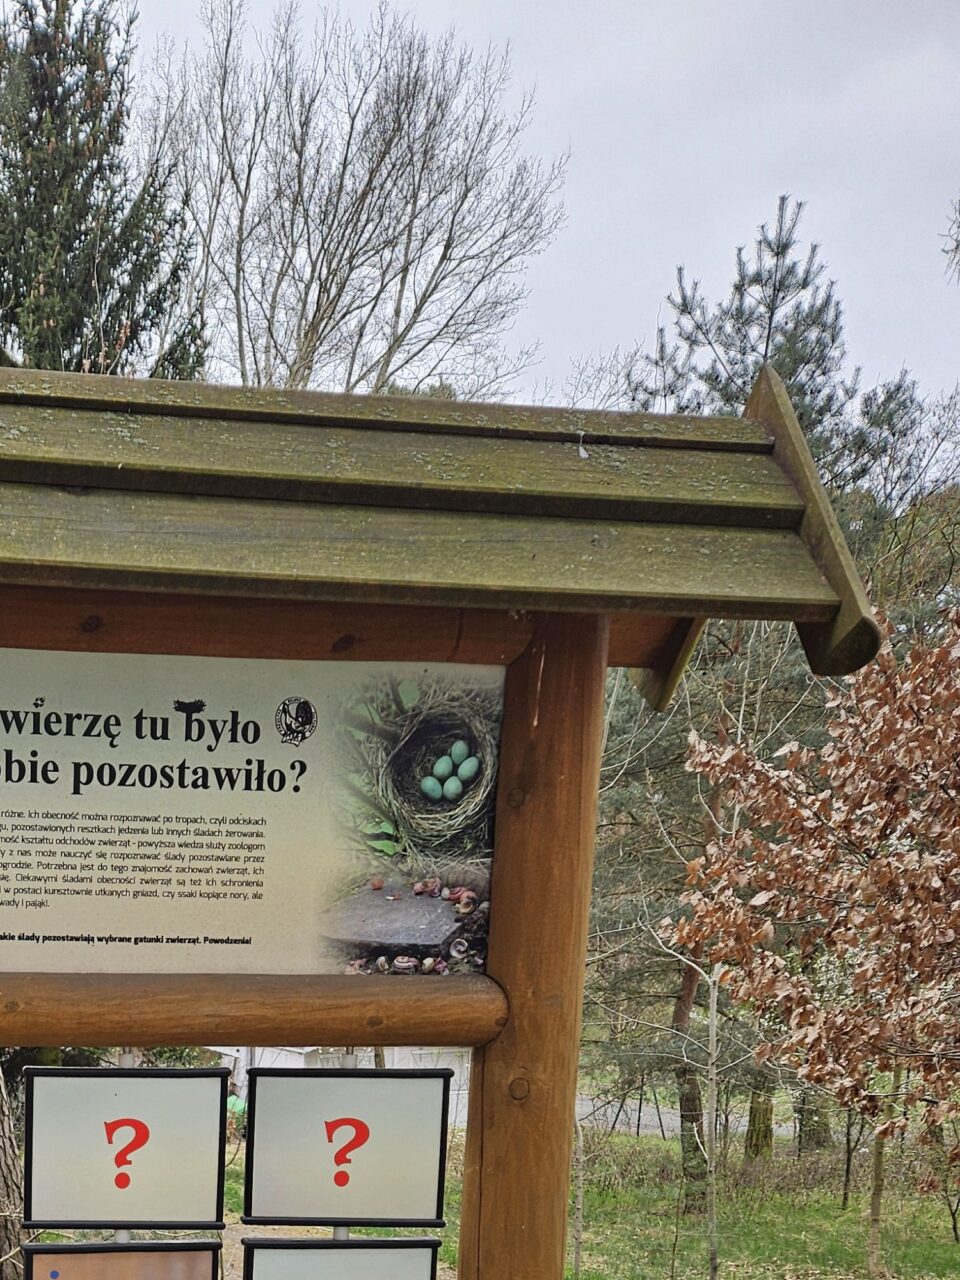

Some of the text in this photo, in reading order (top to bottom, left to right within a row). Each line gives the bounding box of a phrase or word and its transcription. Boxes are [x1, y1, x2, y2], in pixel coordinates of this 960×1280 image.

[133, 708, 170, 741] tu
[180, 703, 261, 752] było
[71, 757, 308, 796] pozostawiło?
[0, 809, 26, 818] różne.
[27, 809, 40, 819] Ich
[41, 810, 80, 820] obecność
[81, 813, 108, 821] można
[162, 816, 174, 825] po
[174, 815, 208, 825] tropach,
[208, 816, 228, 827] czyli
[228, 816, 267, 826] odciskach
[10, 823, 76, 834] pozostawionych
[77, 825, 116, 834] resztkach
[117, 825, 150, 836] jedzenia
[151, 826, 164, 836] lub
[165, 827, 191, 838] innych
[193, 827, 223, 837] śladach
[21, 835, 54, 845] kształtu
[55, 836, 96, 846] odchodów
[97, 838, 131, 848] zwierząt
[137, 840, 176, 850] powyższa
[176, 840, 204, 849] wiedza
[227, 841, 266, 853] zoologom
[16, 849, 32, 857] nas
[34, 849, 57, 858] może
[60, 850, 92, 860] nauczyć
[95, 850, 108, 860] się
[164, 851, 186, 863] ślady
[188, 854, 241, 863] pozostawiane
[243, 855, 265, 865] przez
[36, 860, 78, 871] Potrzebna
[79, 862, 95, 873] jest
[97, 862, 108, 872] do
[110, 864, 129, 874] tego
[131, 864, 173, 874] znajomość
[174, 865, 214, 874] zachowań
[215, 866, 250, 876] zwierząt,
[252, 866, 265, 875] ich
[15, 873, 58, 884] Ciekawymi
[61, 874, 93, 883] śladami
[96, 873, 136, 885] obecności
[139, 876, 172, 886] zwierząt
[176, 878, 186, 887] są
[189, 878, 202, 886] też
[205, 877, 217, 886] ich
[220, 878, 264, 887] schronienia
[12, 886, 42, 896] postaci
[43, 886, 93, 896] kunsztownie
[94, 887, 131, 898] utkanych
[132, 889, 160, 899] gniazd,
[161, 890, 176, 900] czy
[177, 889, 198, 898] ssaki
[198, 890, 228, 900] kopiące
[229, 892, 250, 901] nory,
[251, 890, 264, 900] ale
[25, 898, 50, 909] pająki.
[17, 932, 41, 943] ślady
[96, 934, 132, 945] wybrane
[133, 935, 164, 945] gatunki
[165, 936, 202, 945] zwierząt.
[203, 936, 252, 945] Powodzenia!
[106, 1119, 149, 1188] ?
[326, 1119, 369, 1186] ?
